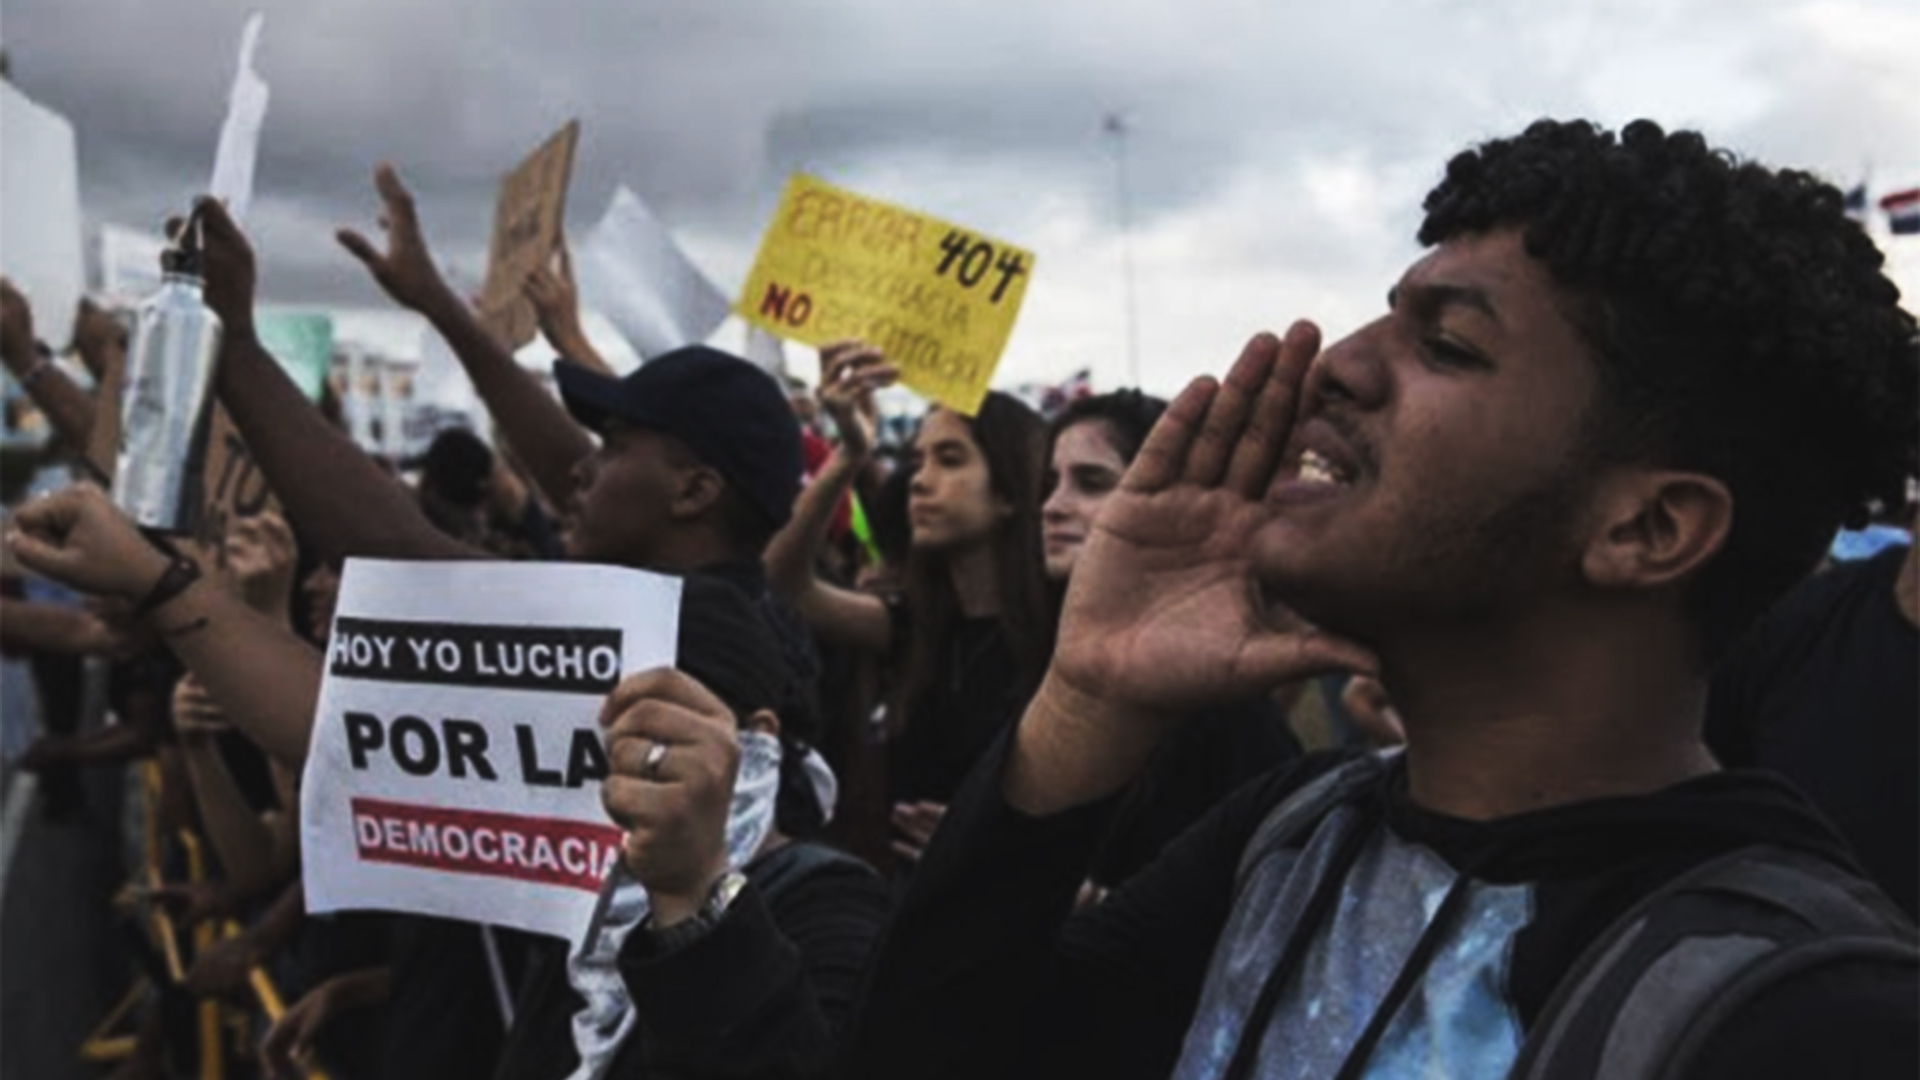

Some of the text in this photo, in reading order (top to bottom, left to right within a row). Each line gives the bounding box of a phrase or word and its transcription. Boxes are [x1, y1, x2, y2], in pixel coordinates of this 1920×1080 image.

[935, 230, 1026, 305] 404
[759, 282, 812, 328] NO
[333, 634, 618, 680] HOY YO LUCHO
[343, 711, 611, 788] POR LA
